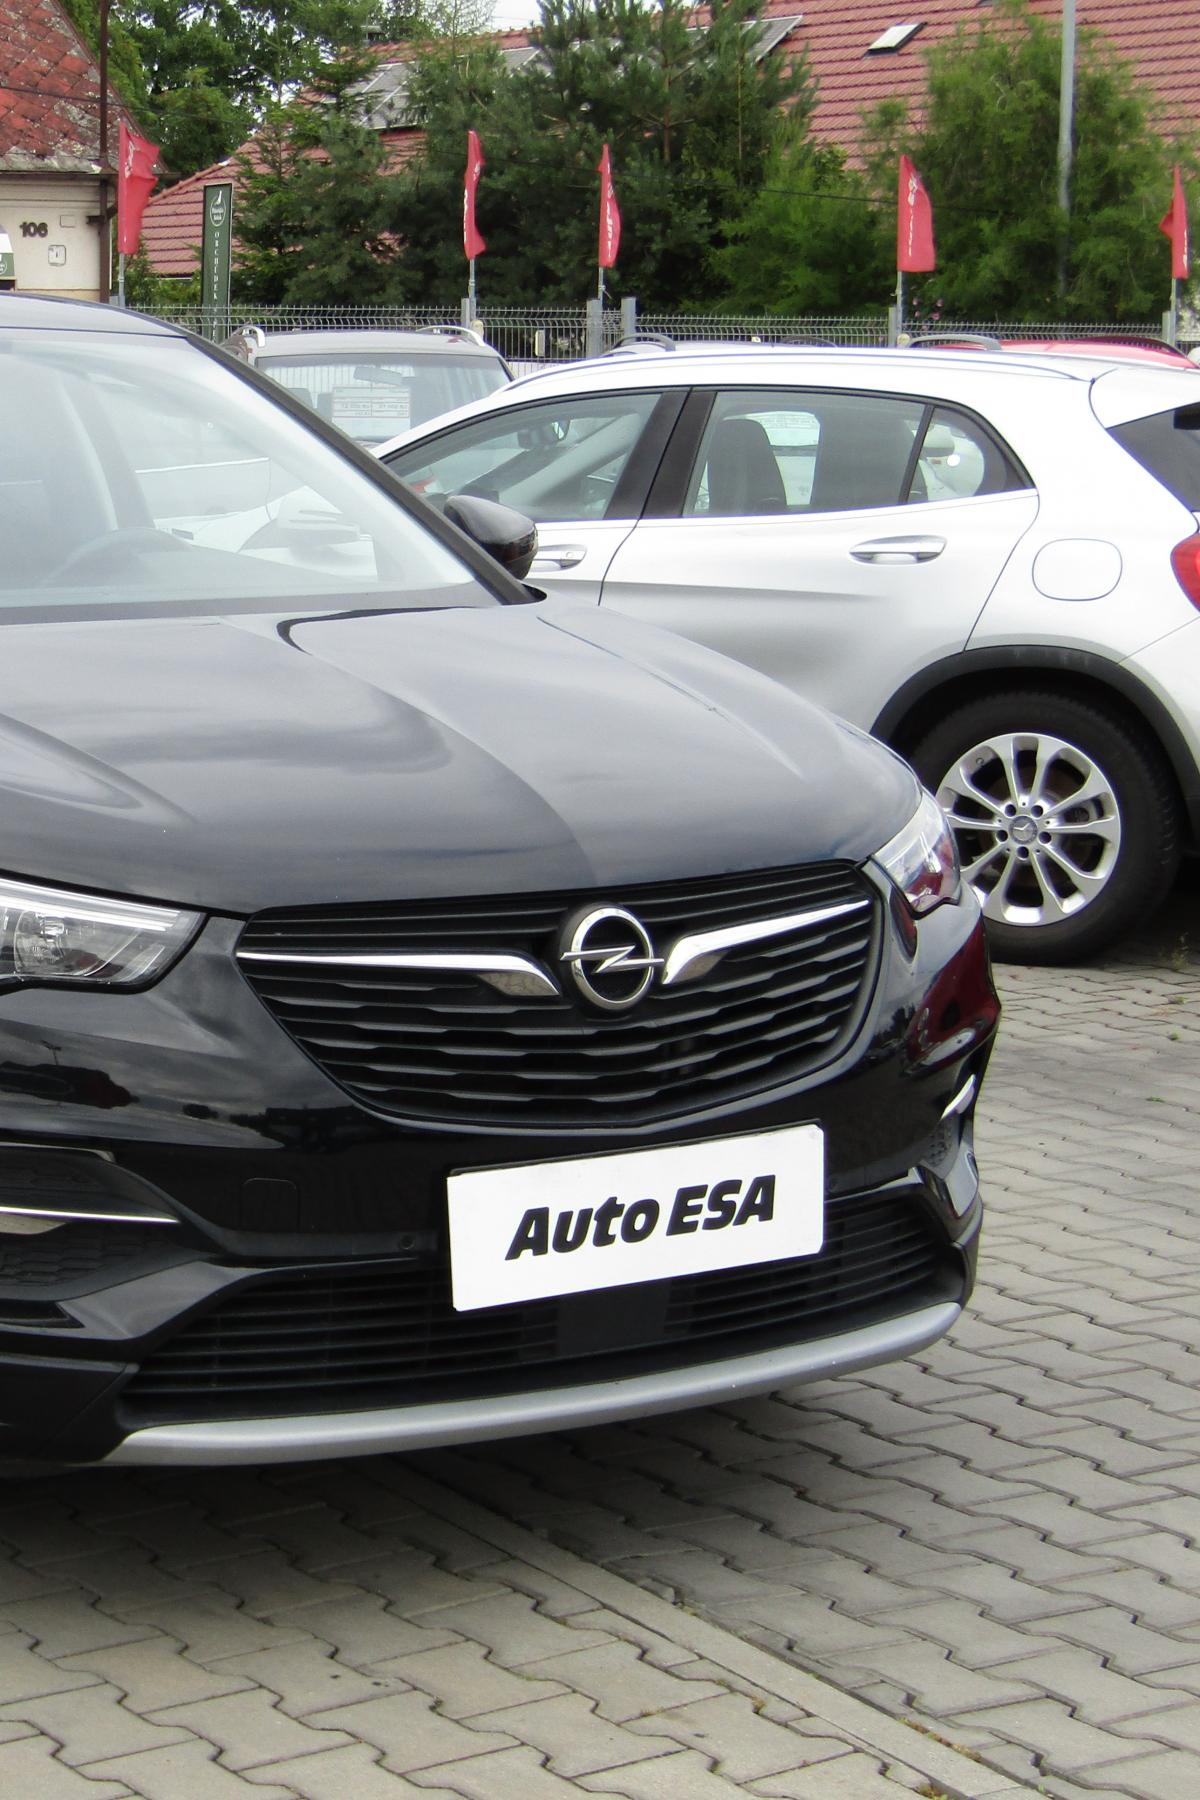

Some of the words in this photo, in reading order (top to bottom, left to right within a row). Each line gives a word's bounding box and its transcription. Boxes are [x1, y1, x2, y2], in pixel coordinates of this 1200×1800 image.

[19, 222, 48, 238] 106
[504, 1196, 661, 1261] Auto
[666, 1174, 776, 1237] ESA
